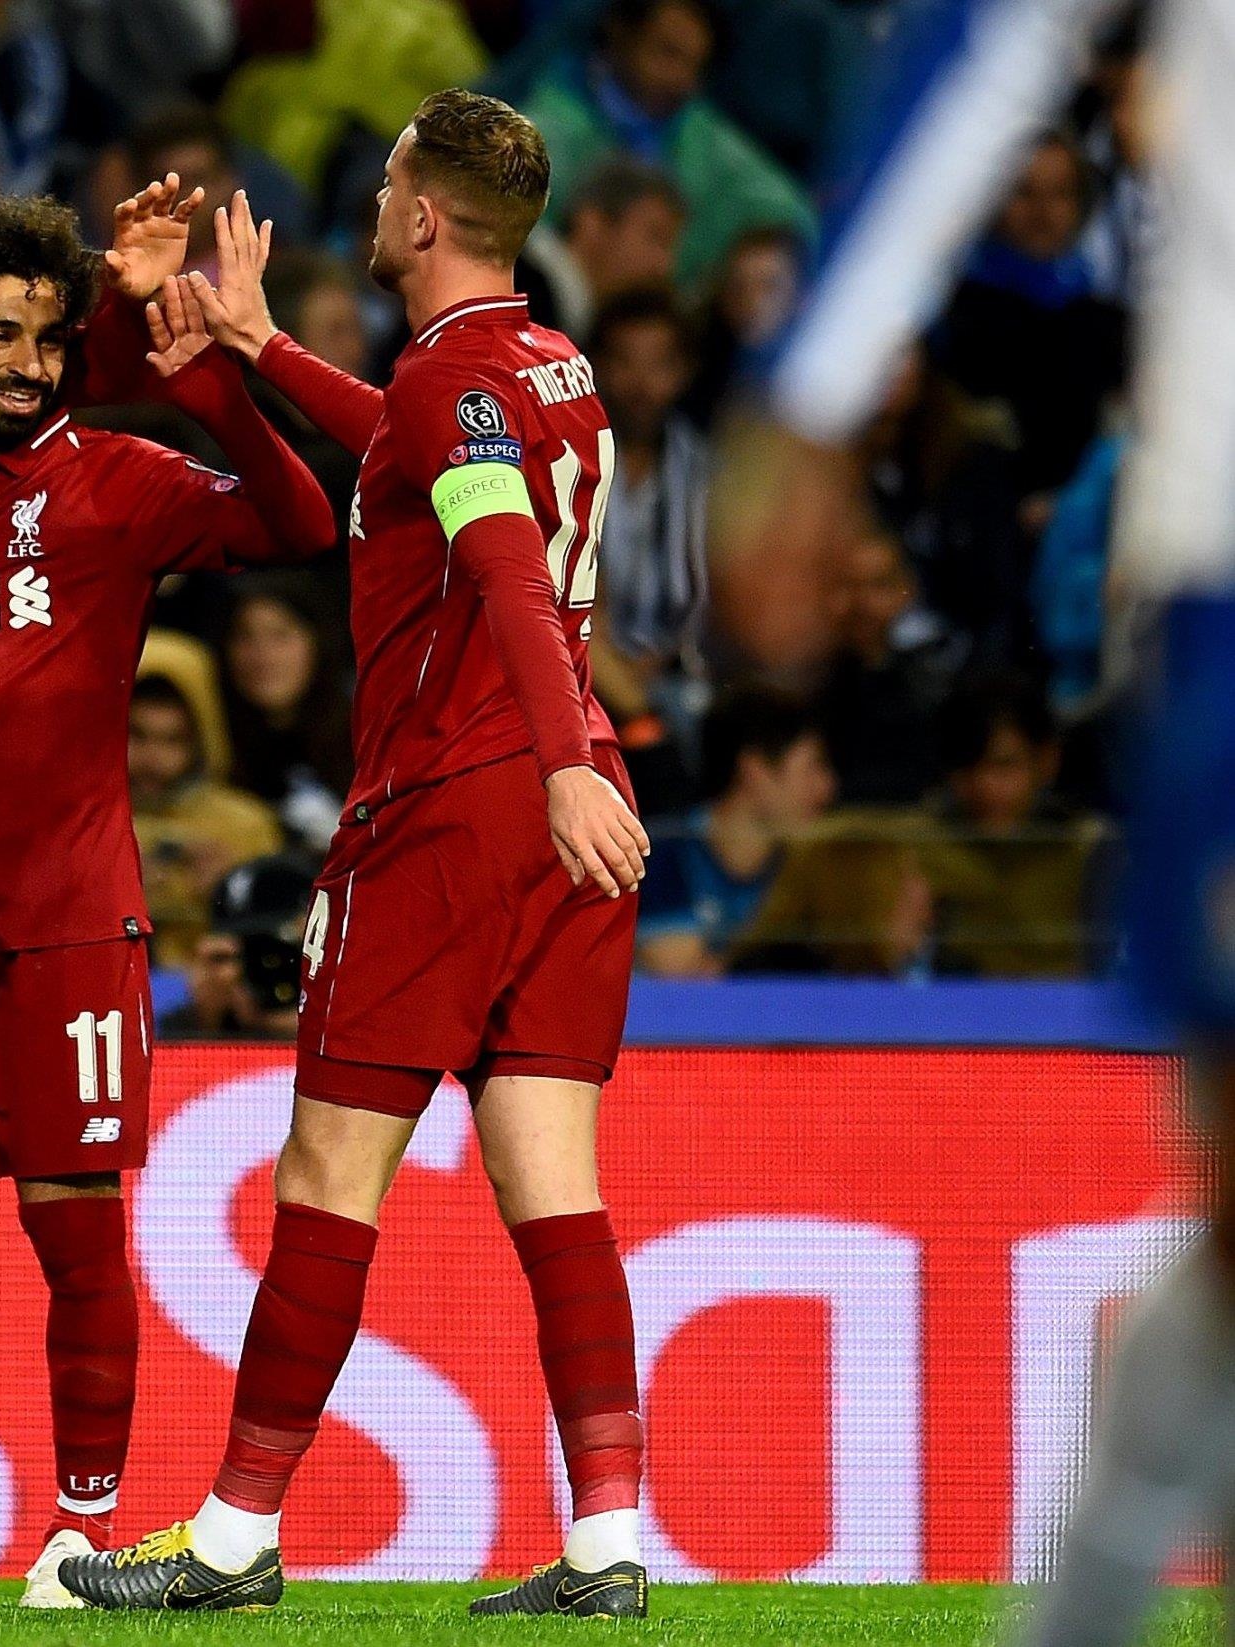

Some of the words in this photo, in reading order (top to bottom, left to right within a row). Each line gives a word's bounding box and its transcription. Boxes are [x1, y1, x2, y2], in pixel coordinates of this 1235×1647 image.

[478, 412, 492, 427] 5
[469, 444, 521, 460] RESPECT
[448, 478, 508, 508] RESPECT
[6, 542, 45, 558] LFC
[65, 1010, 123, 1103] 11
